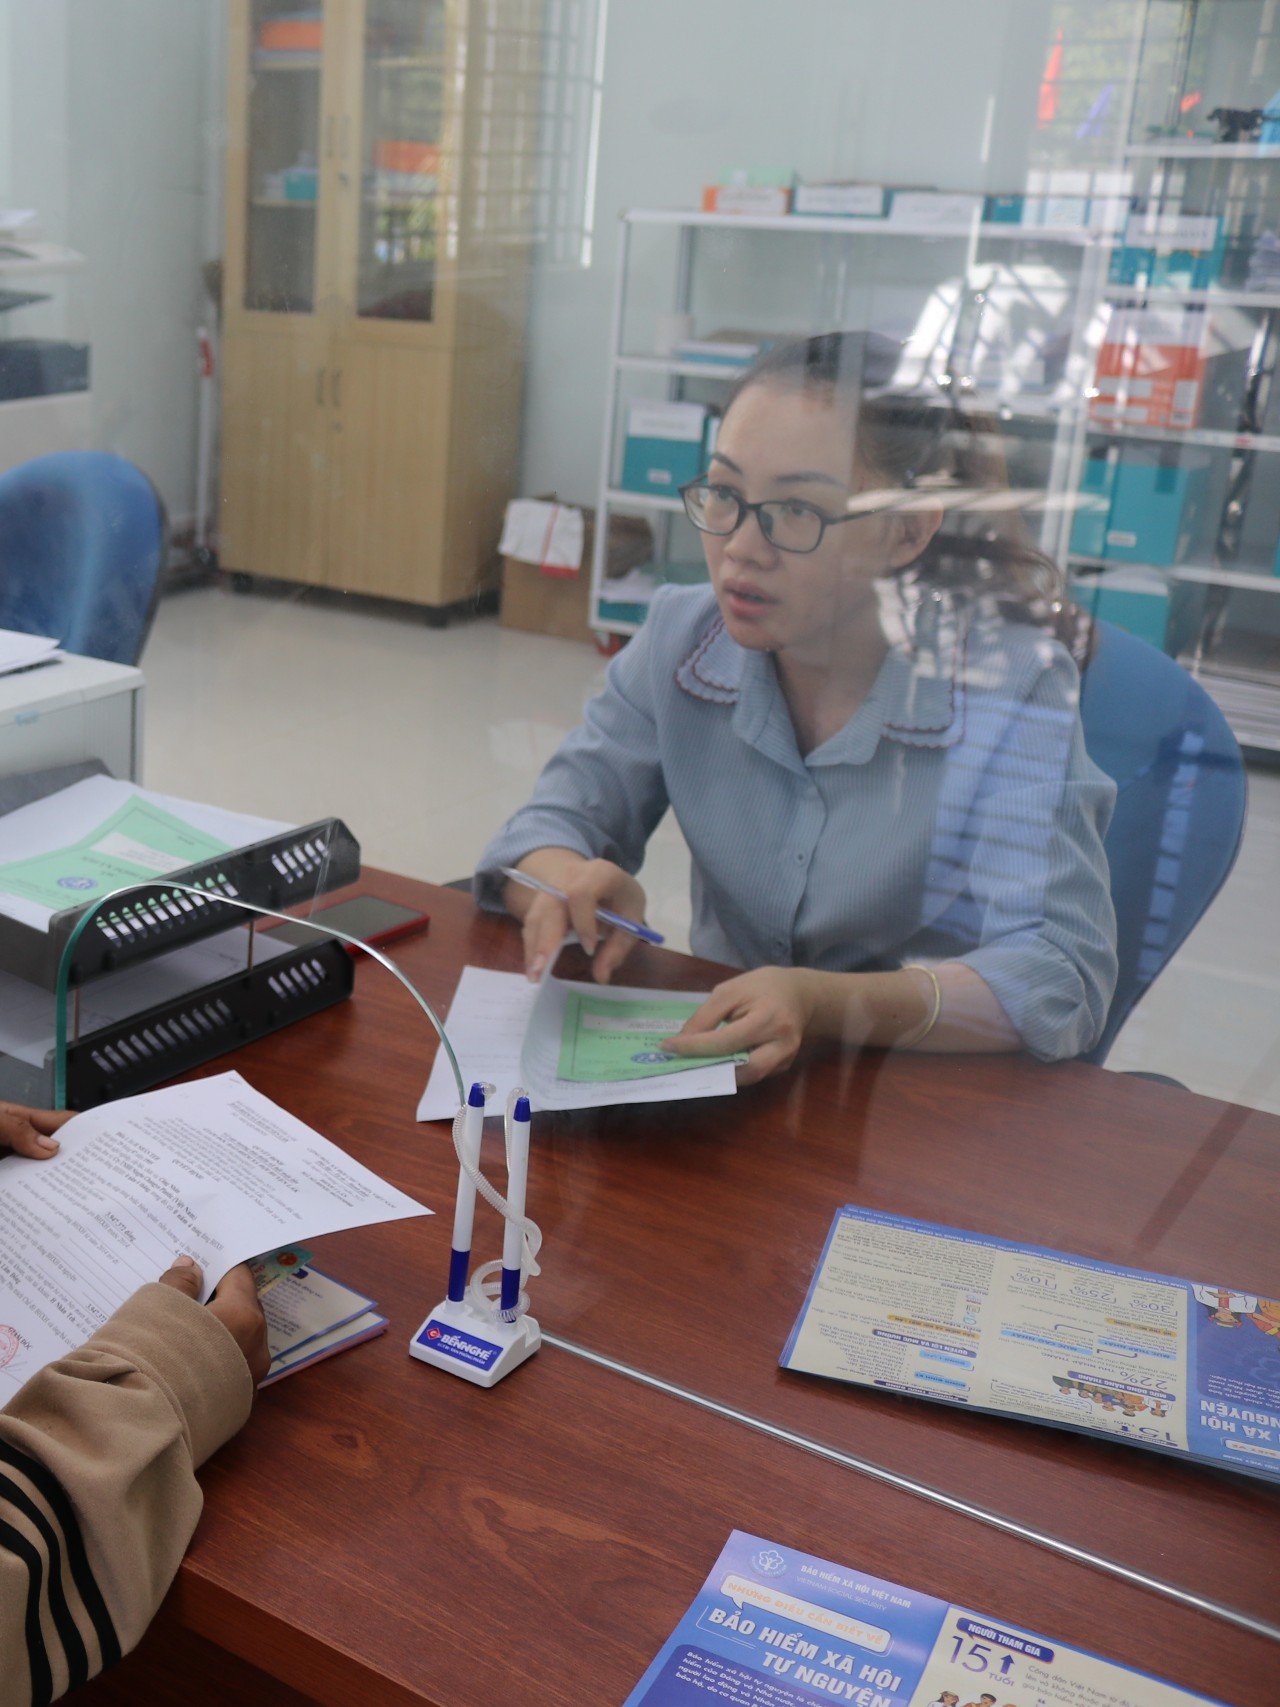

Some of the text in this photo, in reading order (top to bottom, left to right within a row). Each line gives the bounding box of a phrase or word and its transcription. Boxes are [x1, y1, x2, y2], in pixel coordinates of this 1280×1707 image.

[1015, 1272, 1169, 1312] 30% 25% 10%
[1119, 1371, 1167, 1389] 22%
[1201, 1414, 1269, 1441] XÃ HỘI
[801, 1564, 818, 1576] BẢO
[819, 1570, 841, 1584] HIỂM
[842, 1577, 853, 1588] XÃ
[854, 1583, 870, 1594] HỘI
[871, 1588, 889, 1600] VIỆT
[890, 1594, 912, 1609] NAM
[707, 1608, 903, 1694] BẢO HIỂM XÃ HỘI
[949, 1634, 992, 1674] 15
[967, 1622, 1042, 1658] NGƯỜI THAM GIA
[675, 1671, 691, 1683] bảo
[706, 1684, 718, 1693] do
[718, 1689, 730, 1698] cơ
[678, 1664, 702, 1678] người
[702, 1673, 716, 1683] lao
[717, 1679, 739, 1694] động
[740, 1688, 751, 1698] và
[683, 1658, 702, 1669] hiểm
[703, 1665, 718, 1676] của
[720, 1672, 741, 1687] Đảng
[743, 1681, 754, 1690] và
[755, 1685, 773, 1698] Nhà
[686, 1651, 703, 1662] Bảo
[705, 1657, 724, 1670] hiểm
[725, 1667, 737, 1676] xã
[739, 1671, 752, 1682] hội
[761, 1651, 892, 1707] TỰ NGUYỆN
[988, 1672, 1015, 1688] TUỔI
